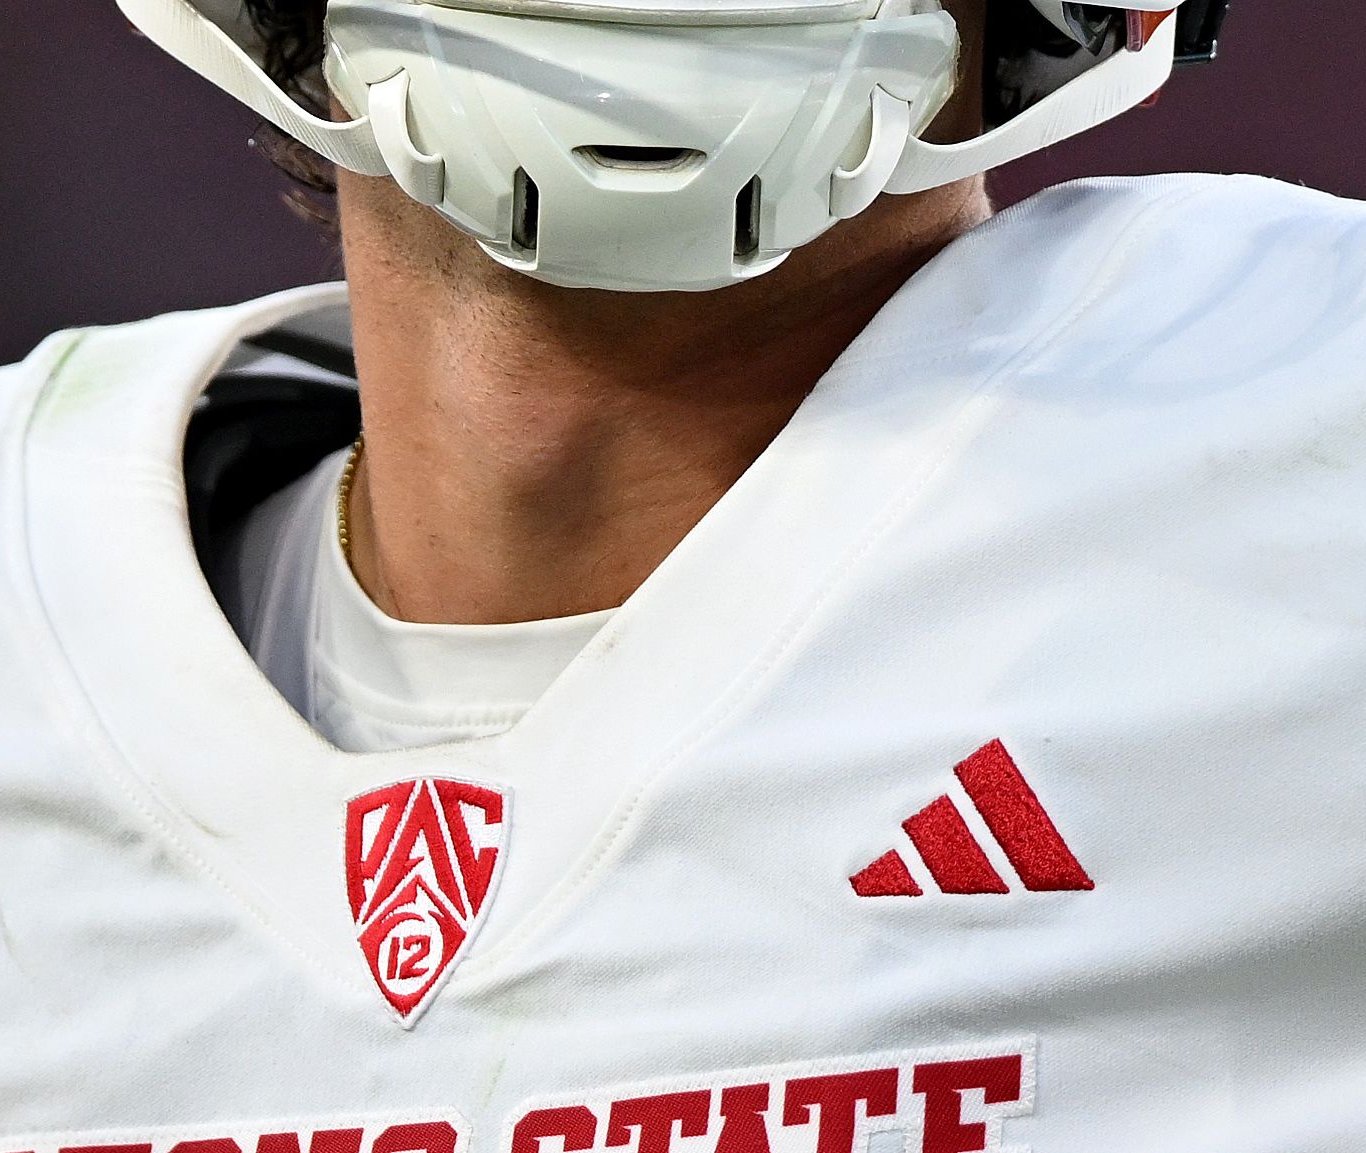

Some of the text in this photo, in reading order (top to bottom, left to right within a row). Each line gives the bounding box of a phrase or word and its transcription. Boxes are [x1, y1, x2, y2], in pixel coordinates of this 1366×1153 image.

[345, 779, 503, 925] PAC
[386, 934, 431, 980] 12
[510, 1054, 1023, 1153] ATE
